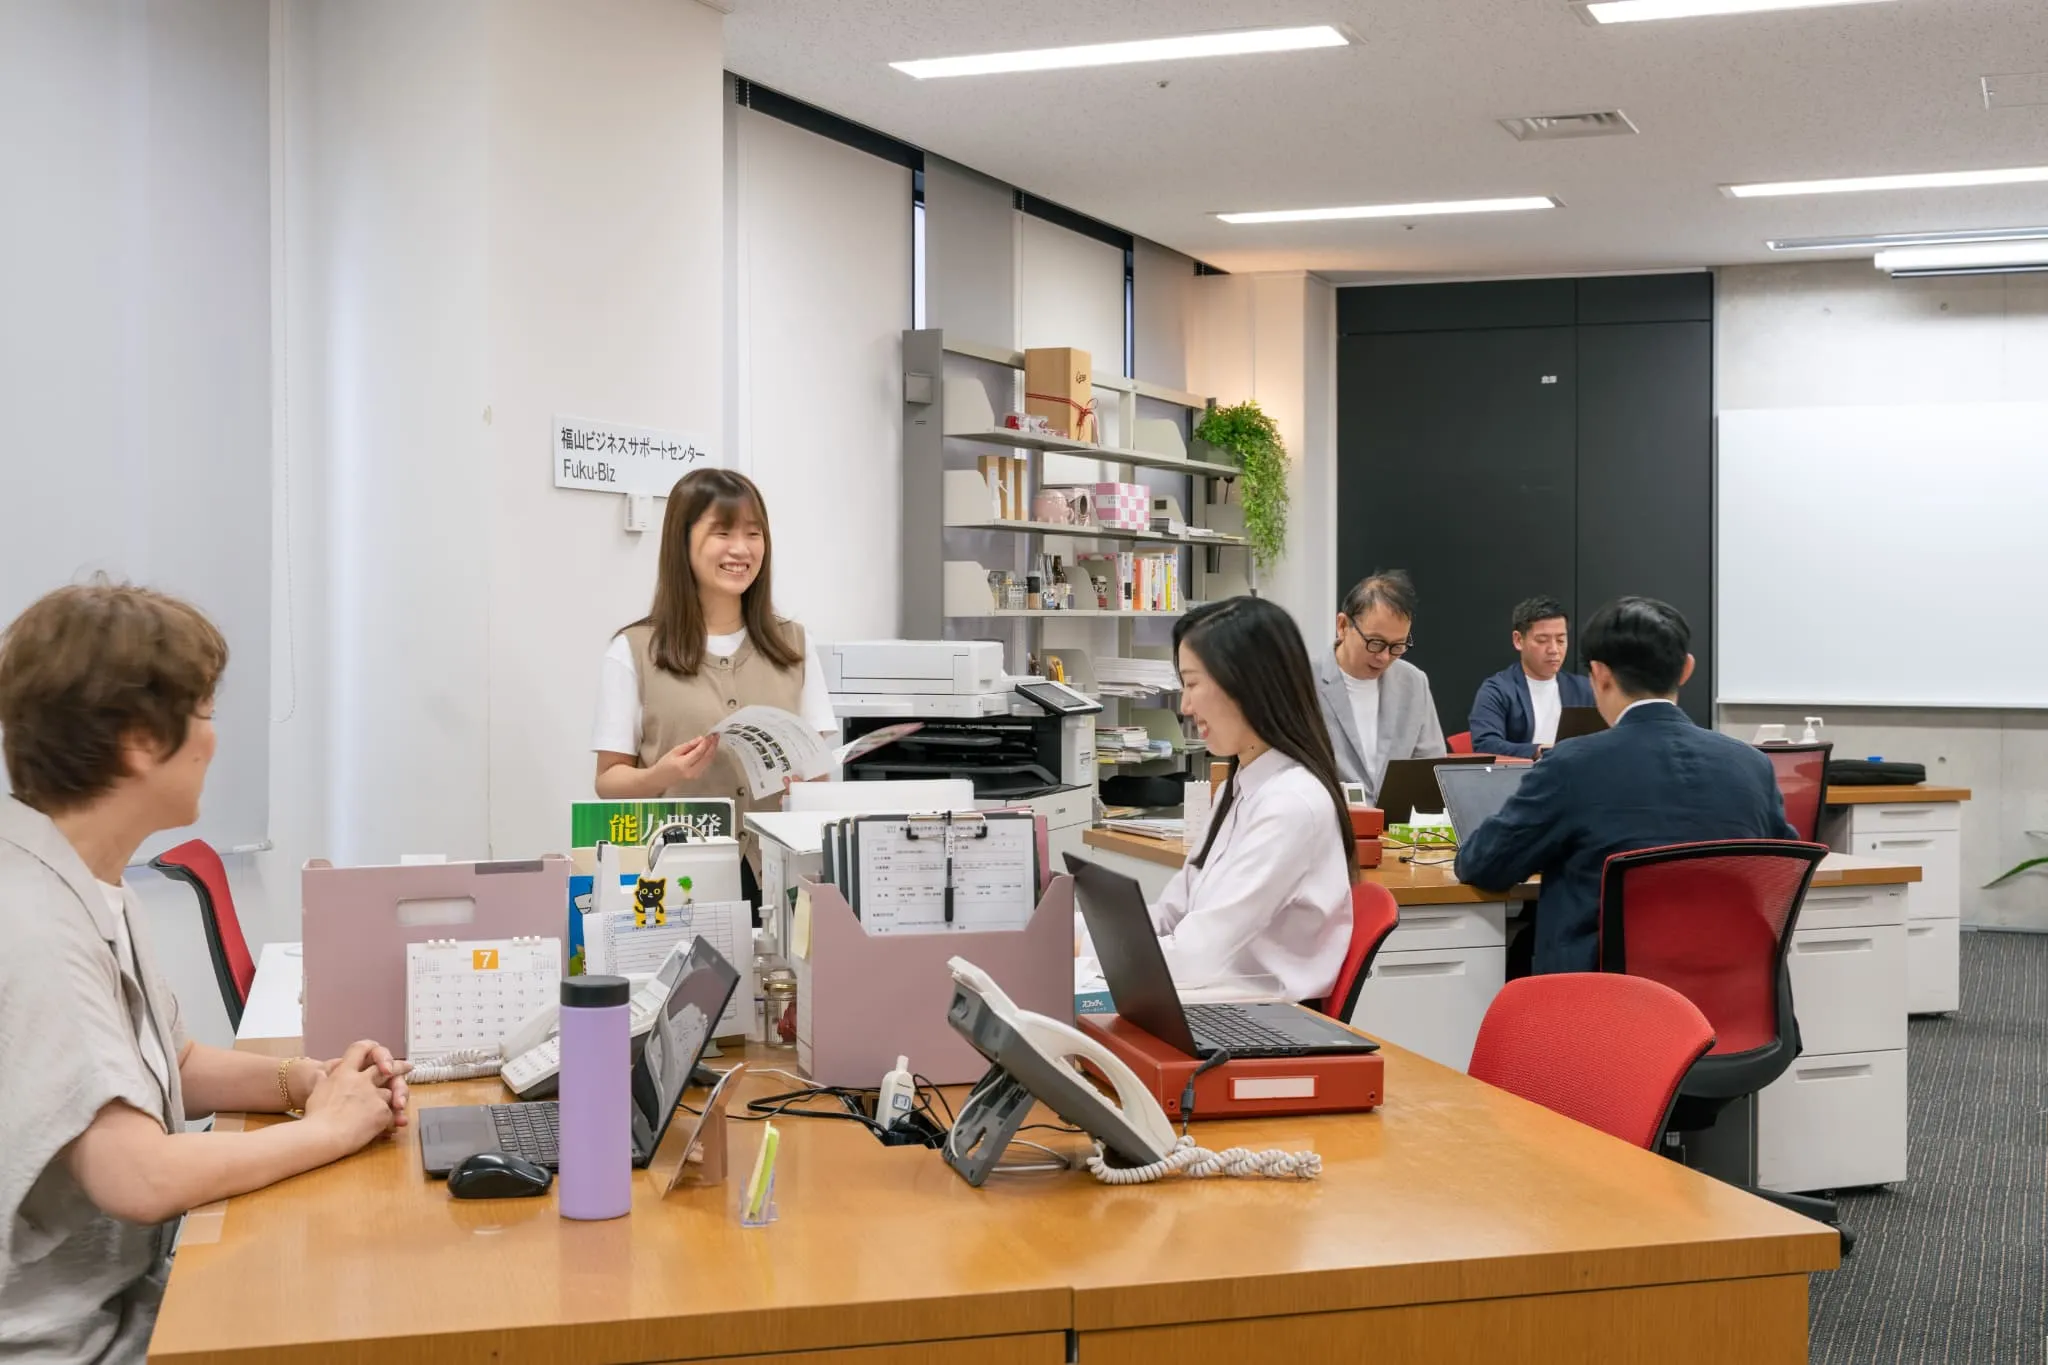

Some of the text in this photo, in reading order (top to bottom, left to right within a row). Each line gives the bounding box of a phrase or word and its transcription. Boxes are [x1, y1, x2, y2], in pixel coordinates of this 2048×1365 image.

[561, 426, 705, 463] 福山ビジネスサポートセンター
[563, 458, 616, 483] Fuku-Biz
[479, 951, 493, 969] 7
